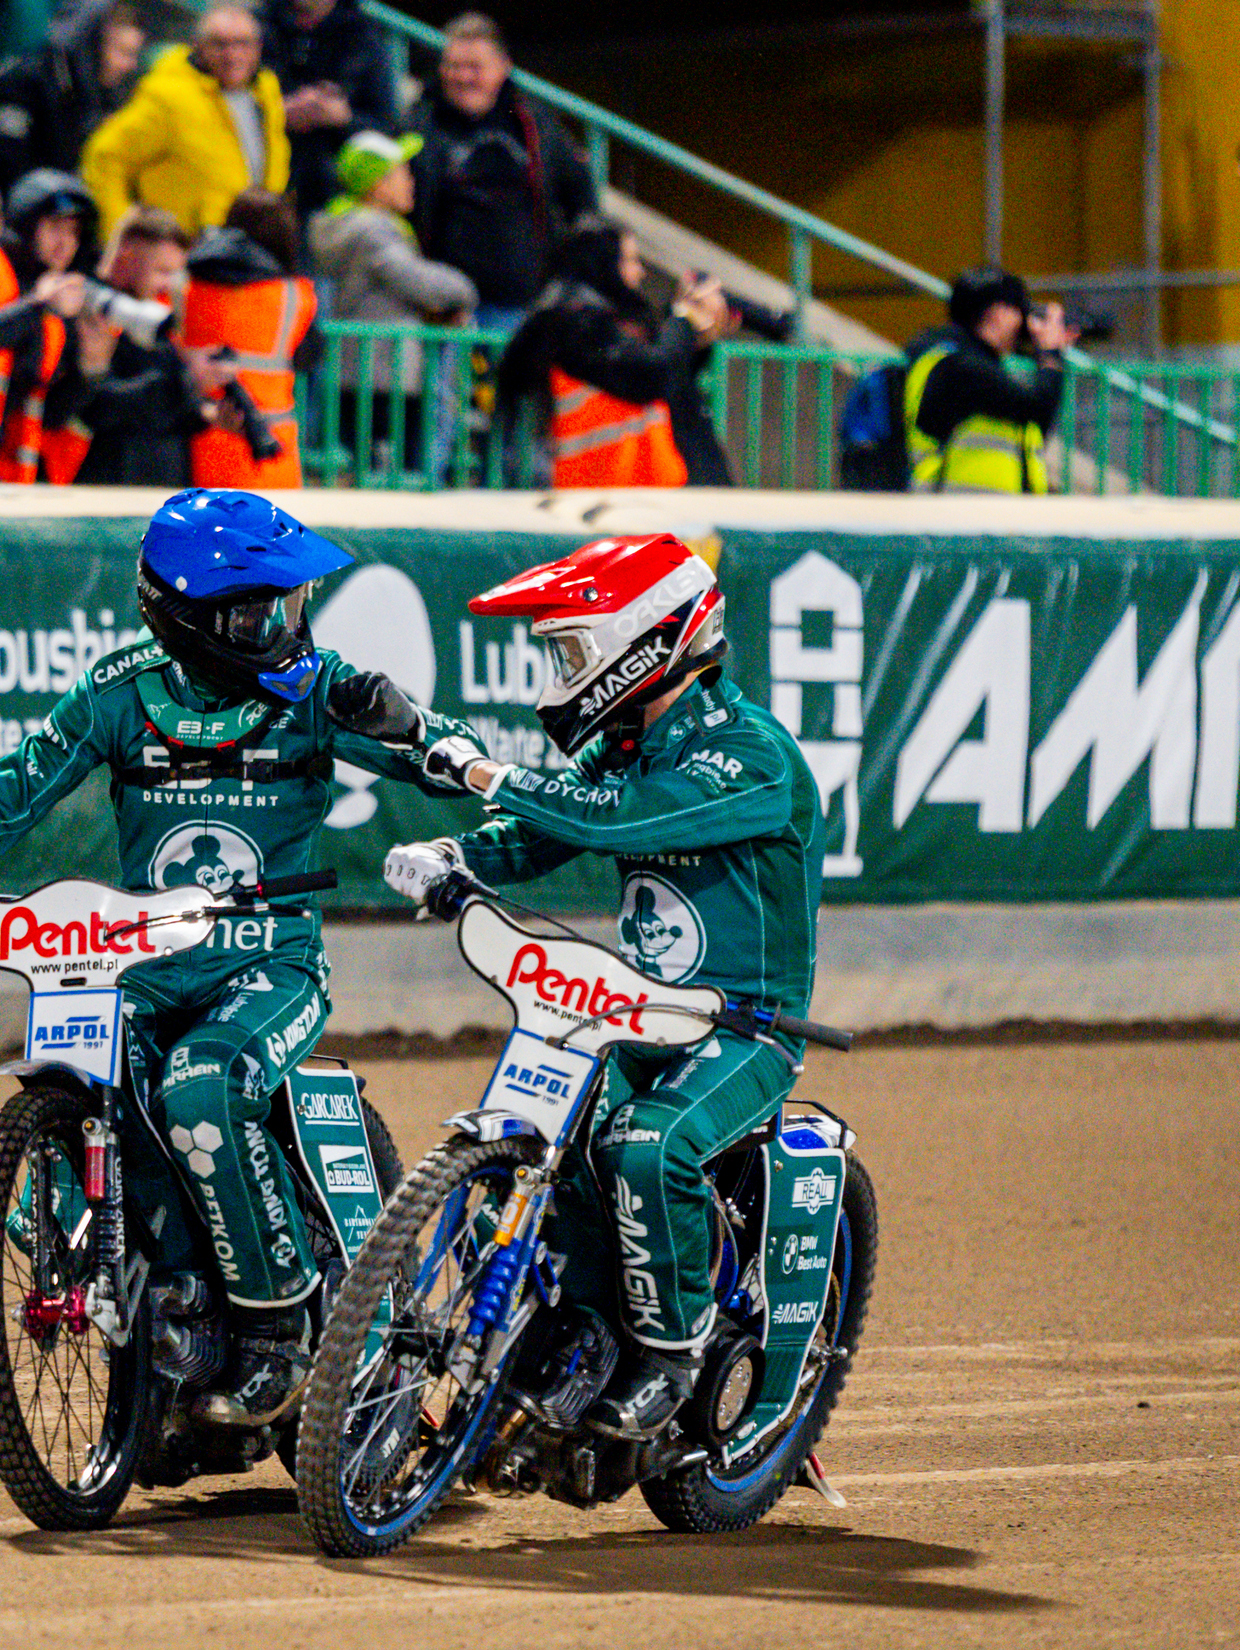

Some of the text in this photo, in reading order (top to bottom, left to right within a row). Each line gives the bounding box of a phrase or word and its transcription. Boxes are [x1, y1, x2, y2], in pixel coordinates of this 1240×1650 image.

[93, 643, 164, 685] CANAL+
[143, 790, 279, 807] DEVELOPMENT
[0, 906, 157, 962] Pentel
[30, 958, 119, 975] wwwpentel.pl
[505, 943, 650, 1036] Pentel
[34, 1023, 111, 1042] ARPOL
[503, 1063, 571, 1100] ARPOL
[300, 1092, 359, 1120] GARCAREK
[334, 1169, 370, 1187] BUD-ROL
[200, 1182, 241, 1282] BETKOM
[801, 1235, 819, 1252] BMW
